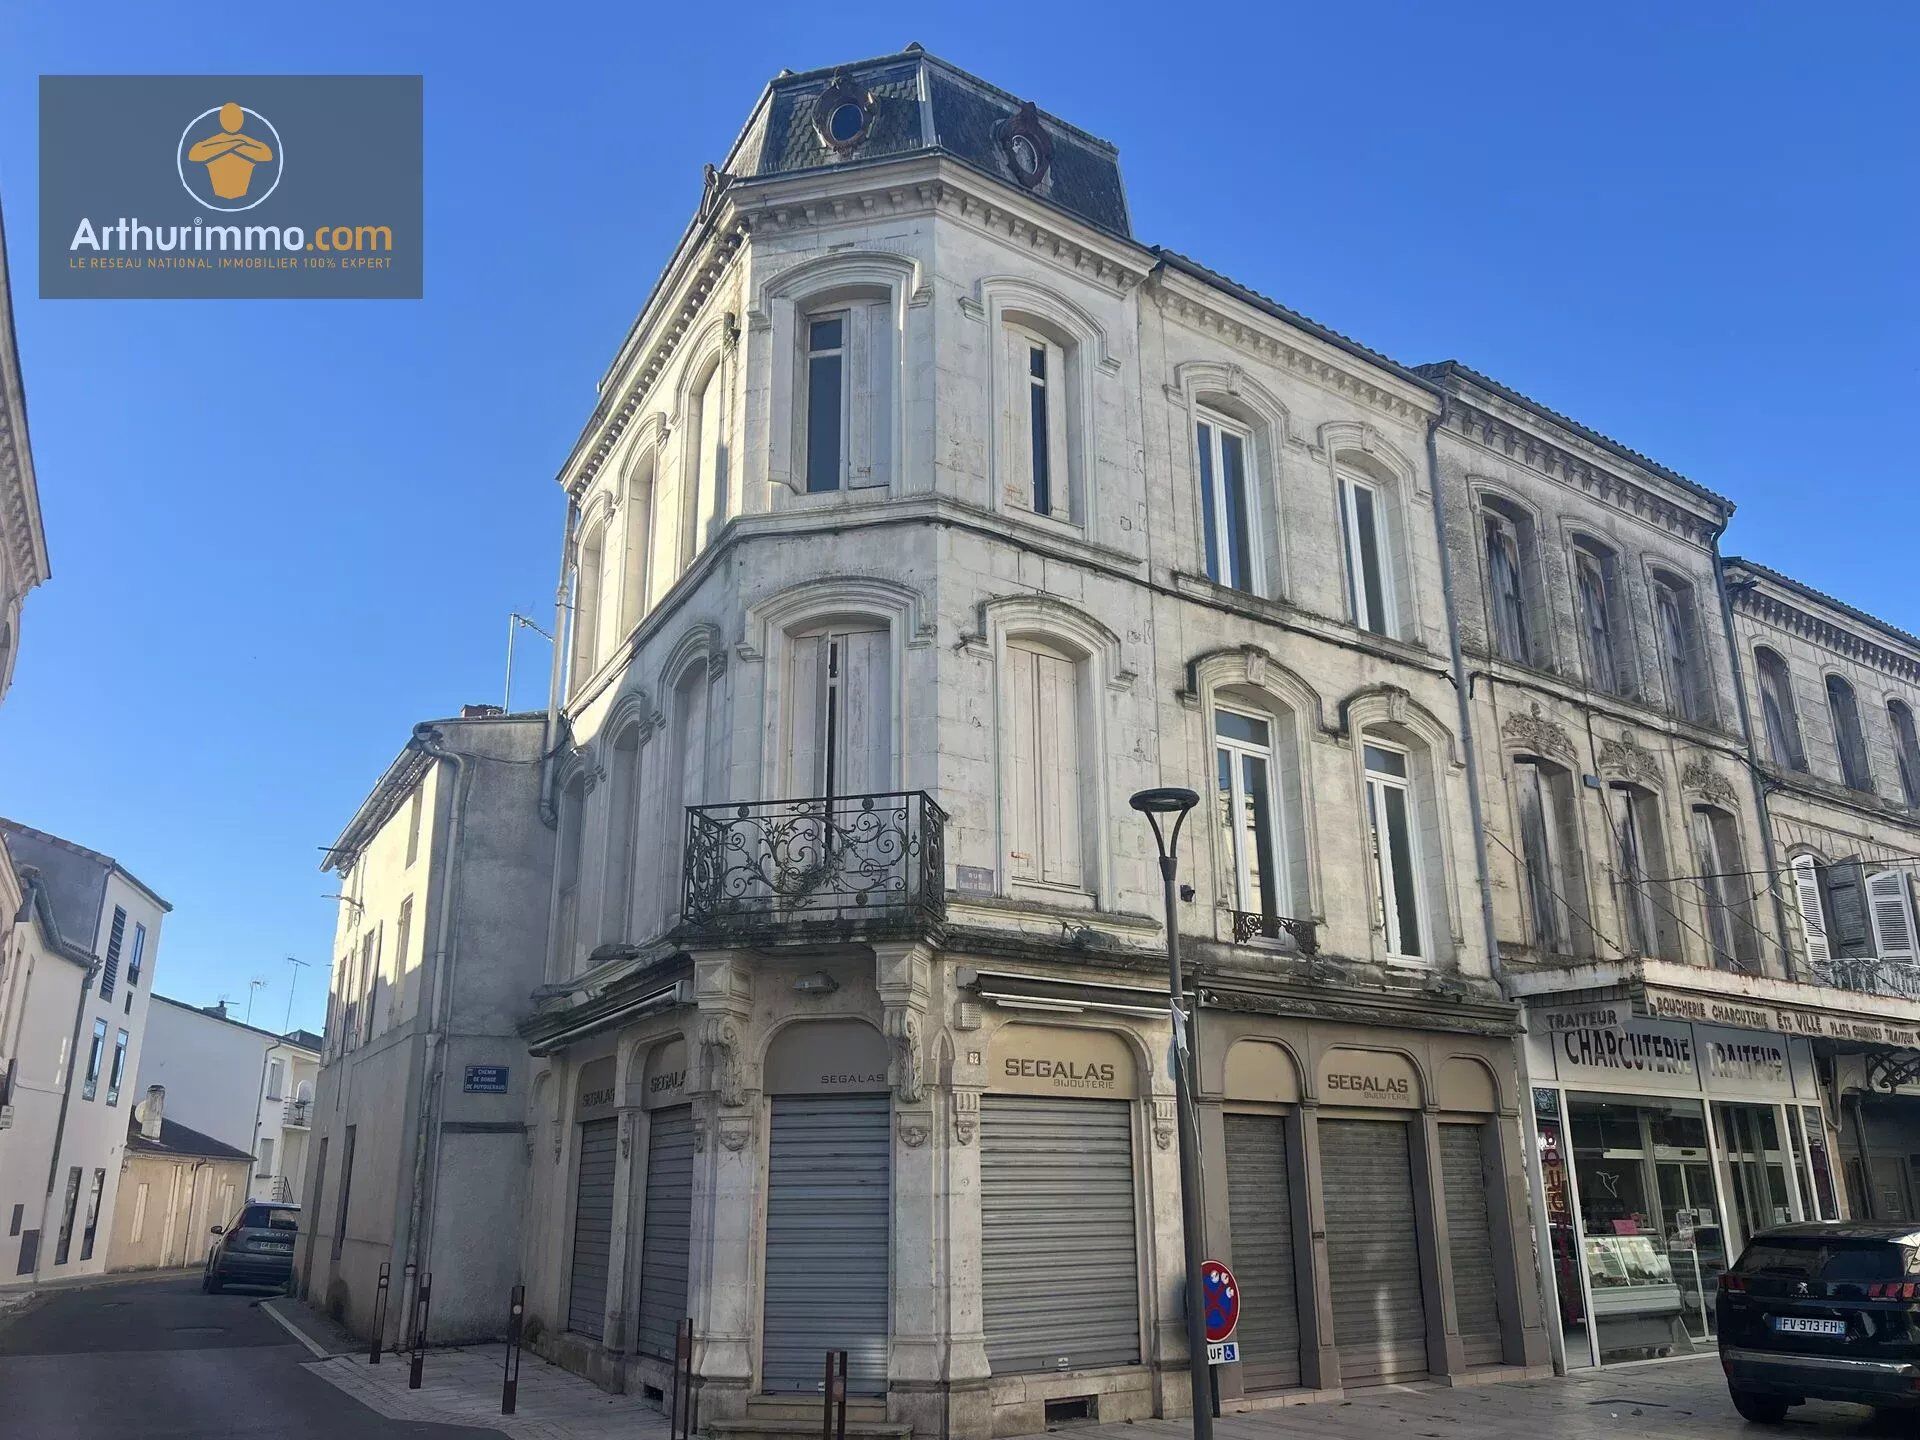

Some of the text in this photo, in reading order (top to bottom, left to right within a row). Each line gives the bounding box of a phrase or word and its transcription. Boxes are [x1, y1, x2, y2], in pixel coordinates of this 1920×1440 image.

[1546, 1009, 1618, 1029] TRAITEUR
[1656, 997, 1706, 1017] BOUCHERIE
[1711, 1005, 1768, 1028] CHARCUTERIE
[1795, 1013, 1823, 1034] VILLE
[1829, 1021, 1853, 1039] PLATS
[967, 1052, 980, 1065] 62
[1564, 1029, 1786, 1082] CHARCUTERIE TRAITEUR
[820, 1073, 886, 1085] SEGALAS
[1004, 1058, 1115, 1081] SEGALAS
[1053, 1078, 1115, 1090] BIJOUTERIE
[1327, 1073, 1409, 1094] SEGALAS
